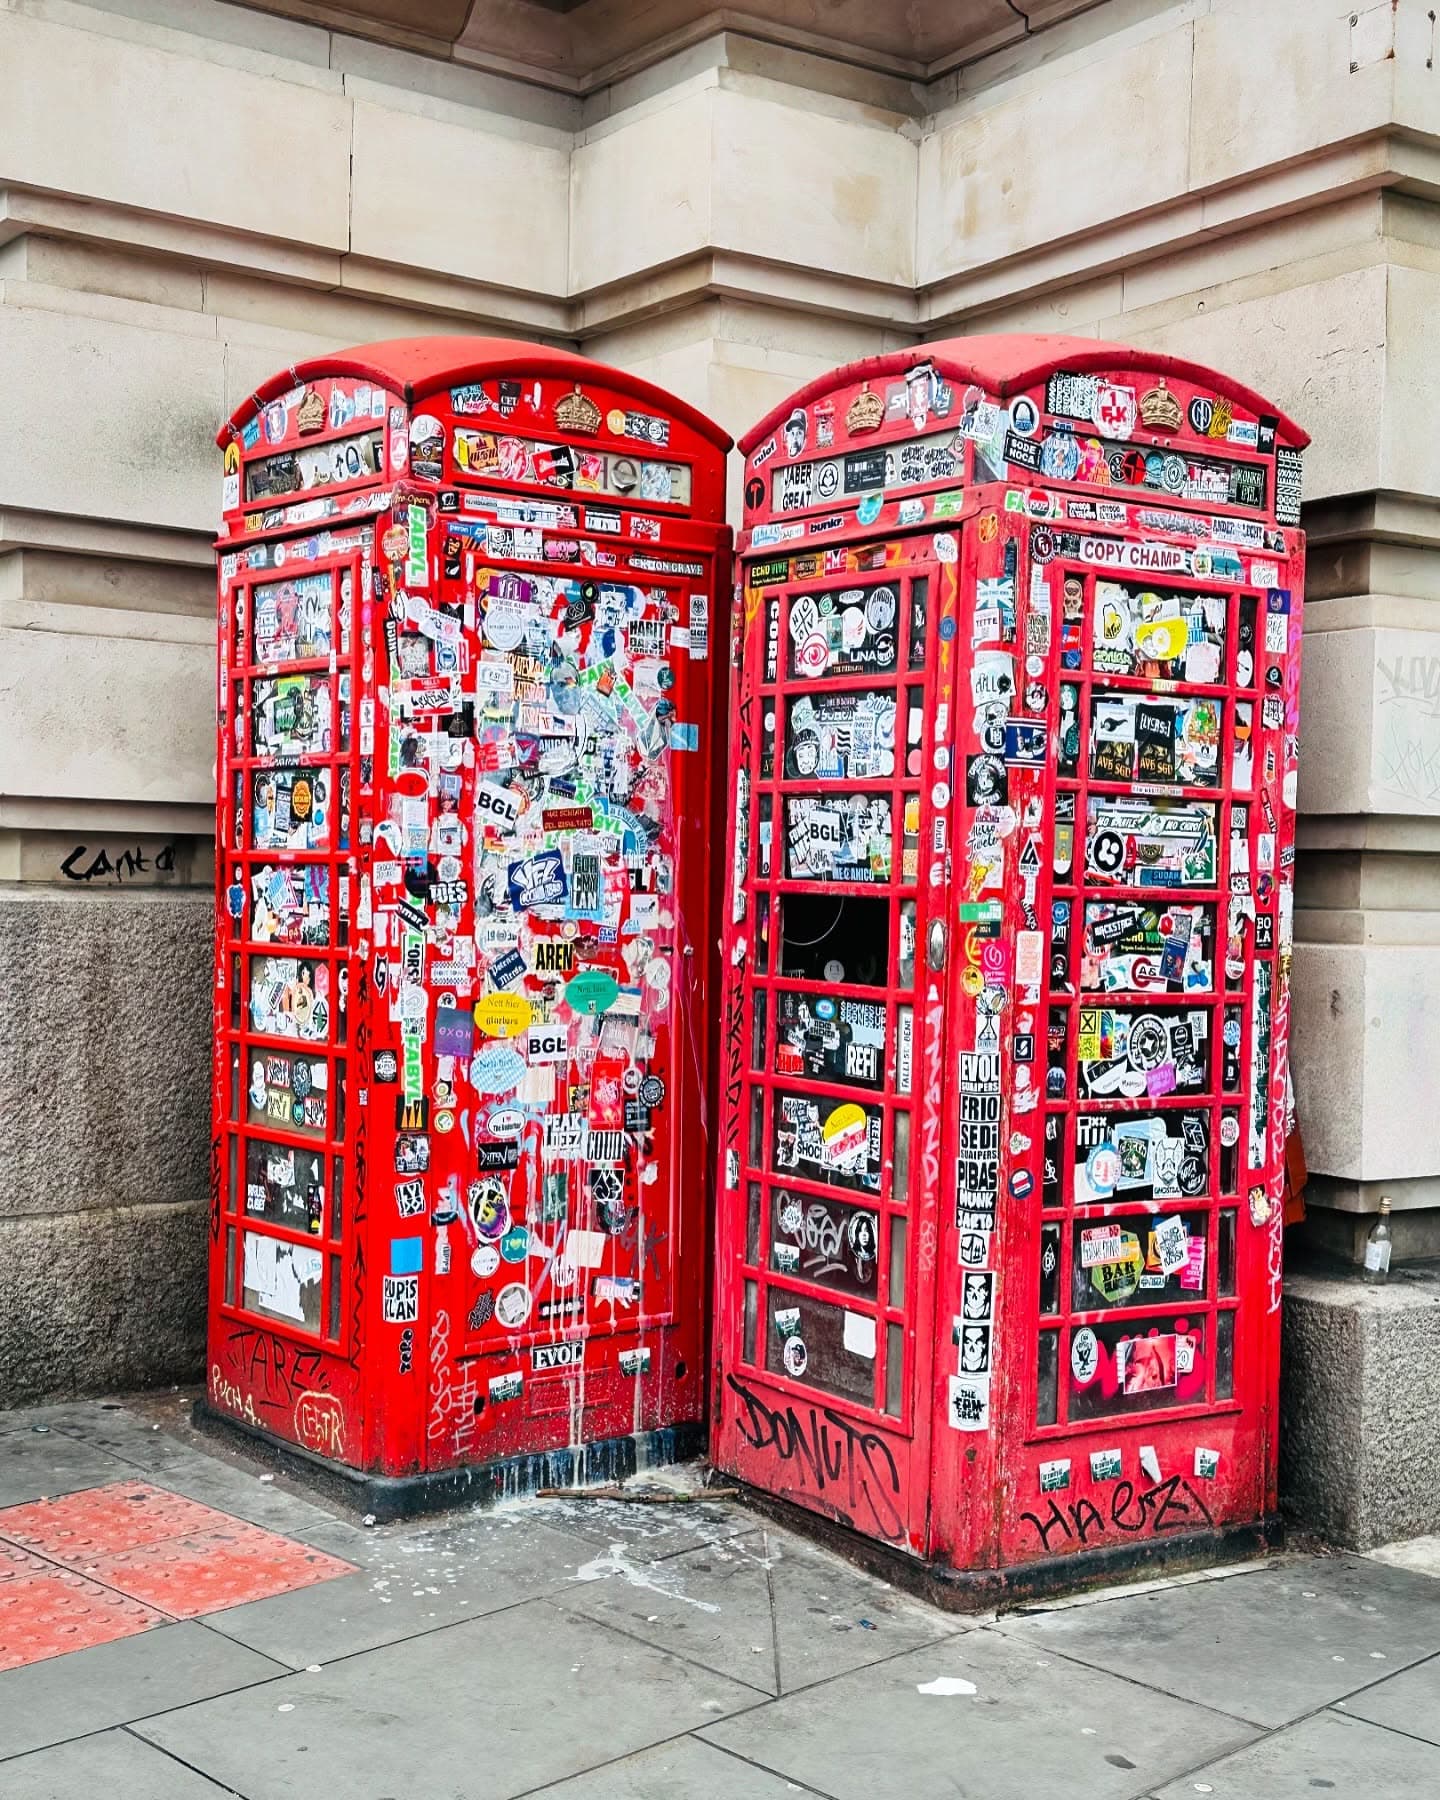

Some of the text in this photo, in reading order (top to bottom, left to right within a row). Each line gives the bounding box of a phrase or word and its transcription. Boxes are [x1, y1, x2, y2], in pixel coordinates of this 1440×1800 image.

[783, 463, 812, 485] JABER
[782, 490, 812, 511] GREAT
[1084, 540, 1181, 567] COPY CHAMP
[478, 791, 516, 821] BGL
[810, 823, 840, 842] BGL
[1256, 917, 1272, 930] BO
[1256, 930, 1271, 943] LA
[536, 943, 574, 971] AREN
[529, 1037, 567, 1055] BGL
[961, 1054, 999, 1082] EVOL
[962, 1095, 998, 1120] FRIO
[544, 1113, 581, 1132] PEAK
[958, 1159, 997, 1190] PIBAS
[384, 1299, 416, 1320] KLAN
[534, 1343, 582, 1368] EVOL
[727, 1372, 906, 1541] DONUTS
